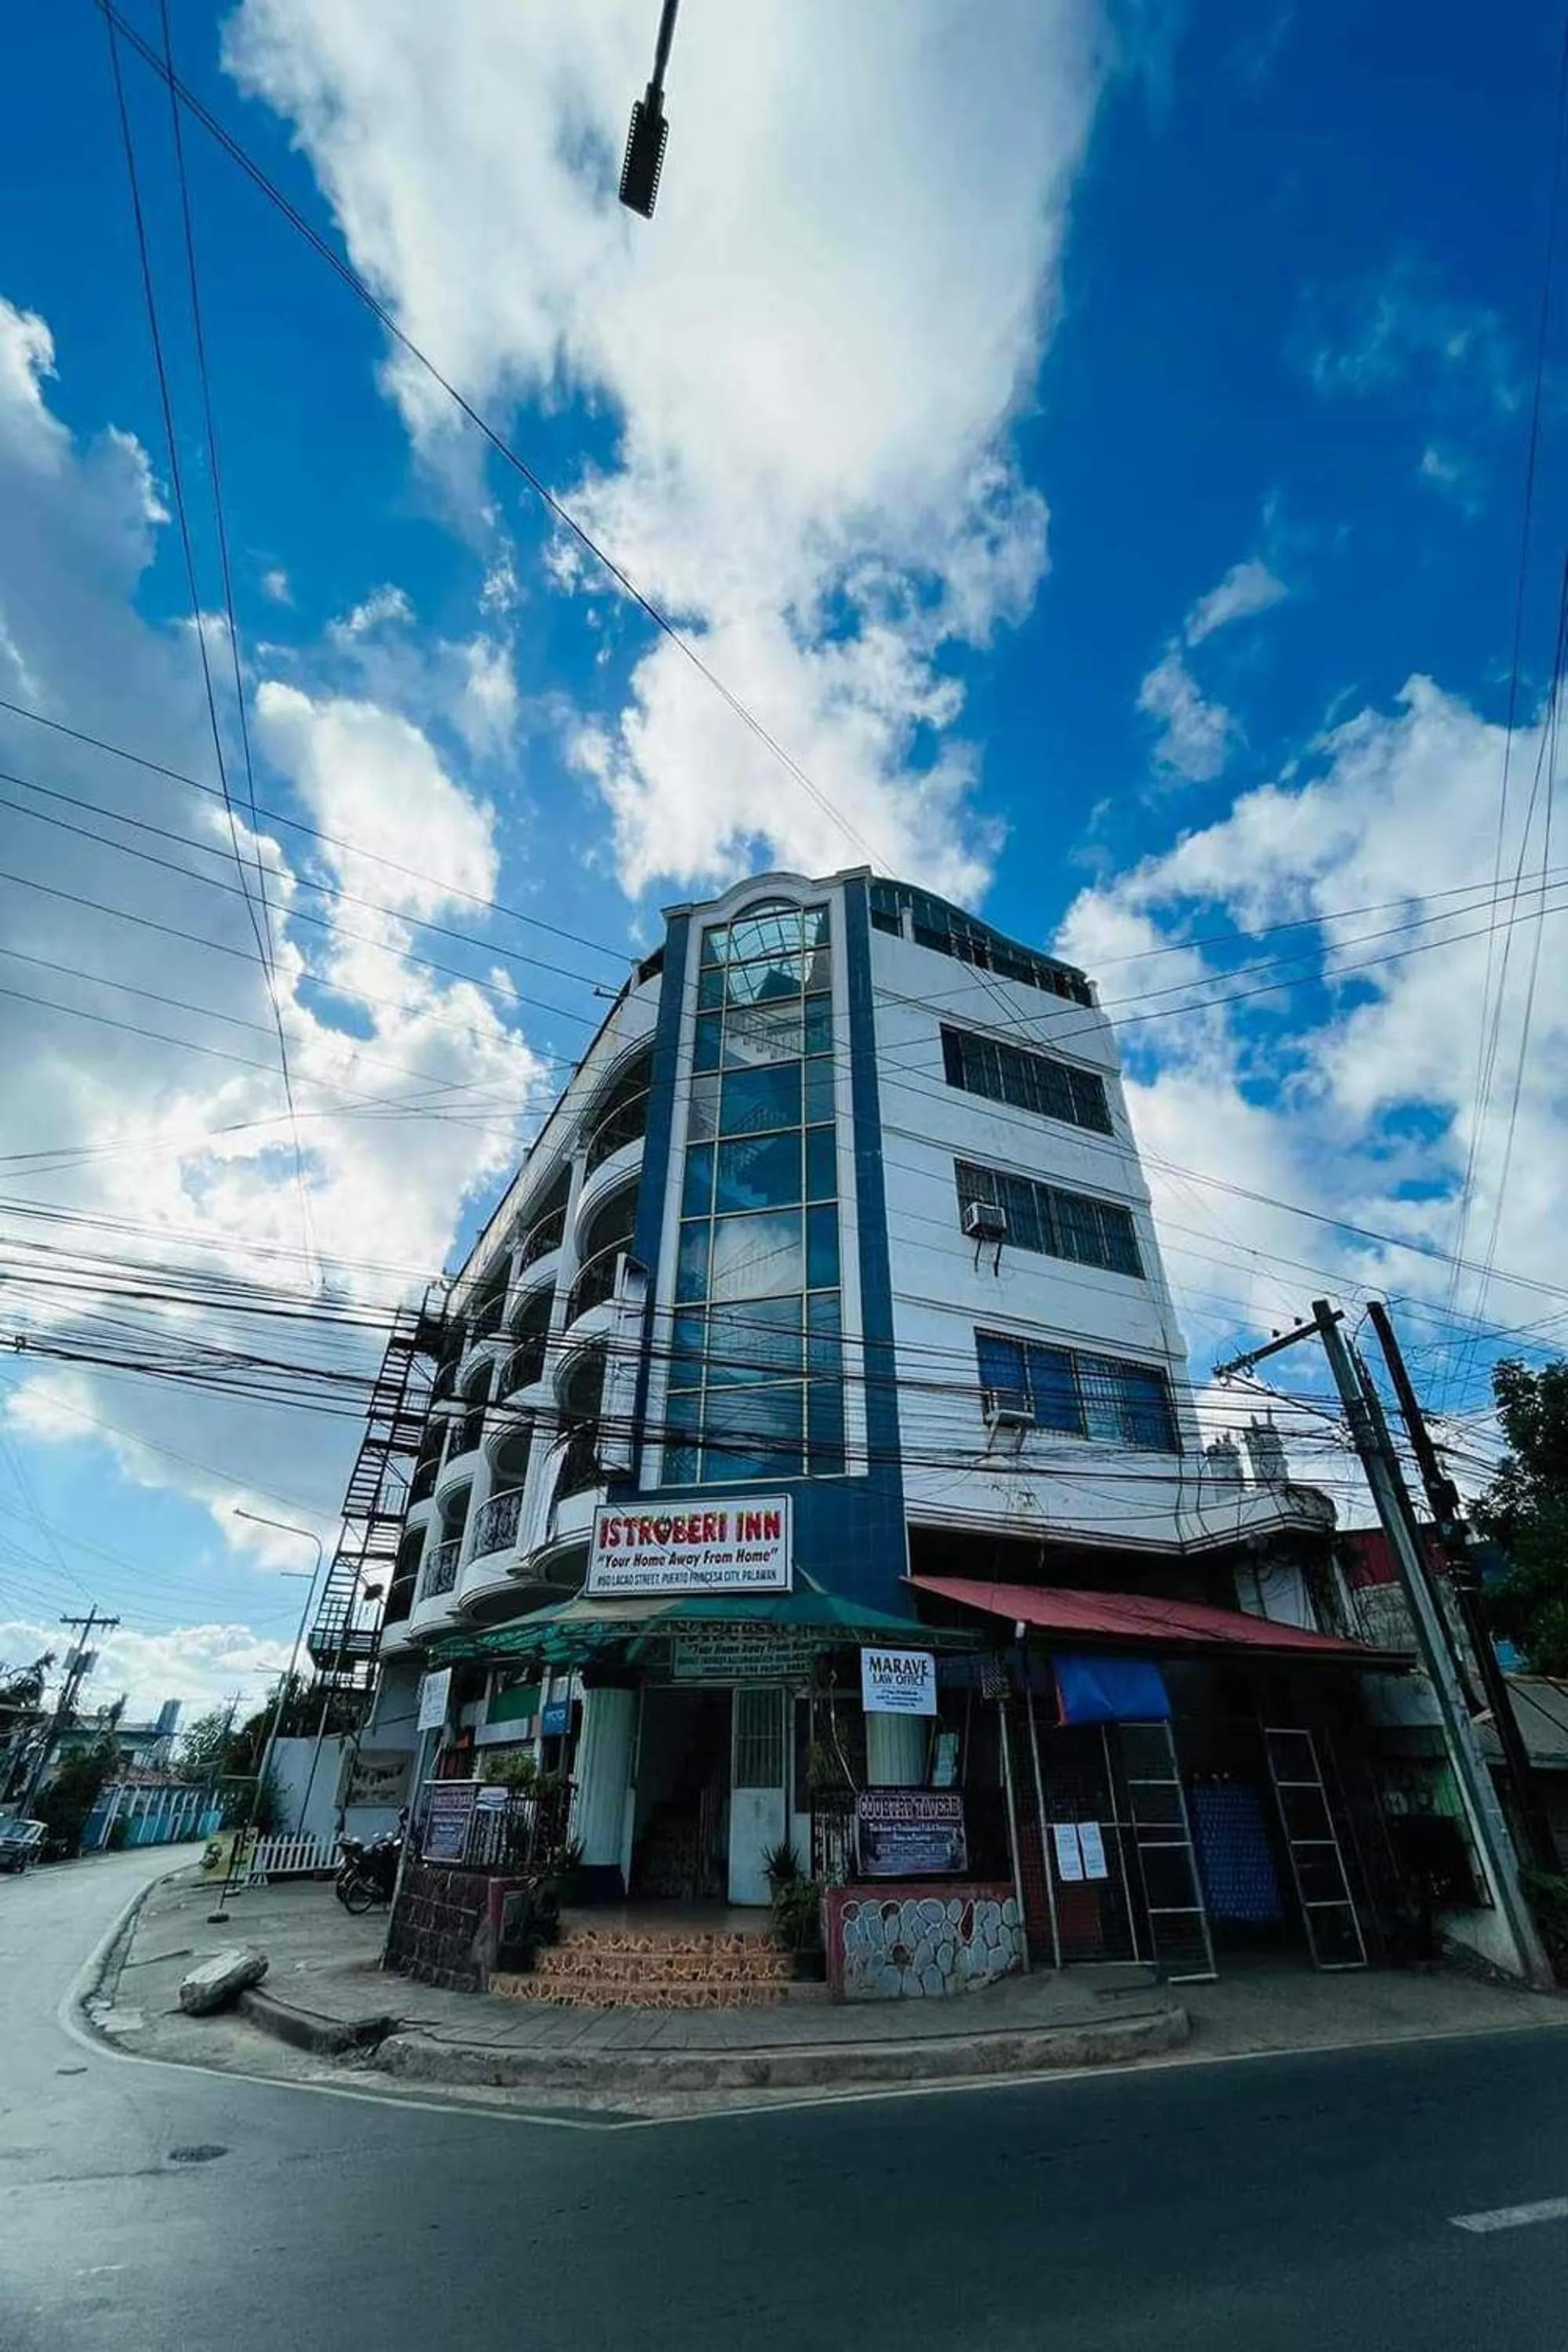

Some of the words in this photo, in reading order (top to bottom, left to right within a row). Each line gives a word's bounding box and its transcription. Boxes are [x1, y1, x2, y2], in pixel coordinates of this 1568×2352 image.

[599, 1513, 728, 1549] ISTROBERI
[736, 1510, 781, 1543] INN
[597, 1553, 630, 1568] "Your
[633, 1553, 666, 1567] Home
[668, 1551, 700, 1567] Away
[703, 1548, 733, 1564] From
[735, 1547, 779, 1563] Home"
[869, 1655, 928, 1677] MARAVE
[872, 1673, 892, 1685] LAW
[895, 1674, 925, 1686] OFFICE
